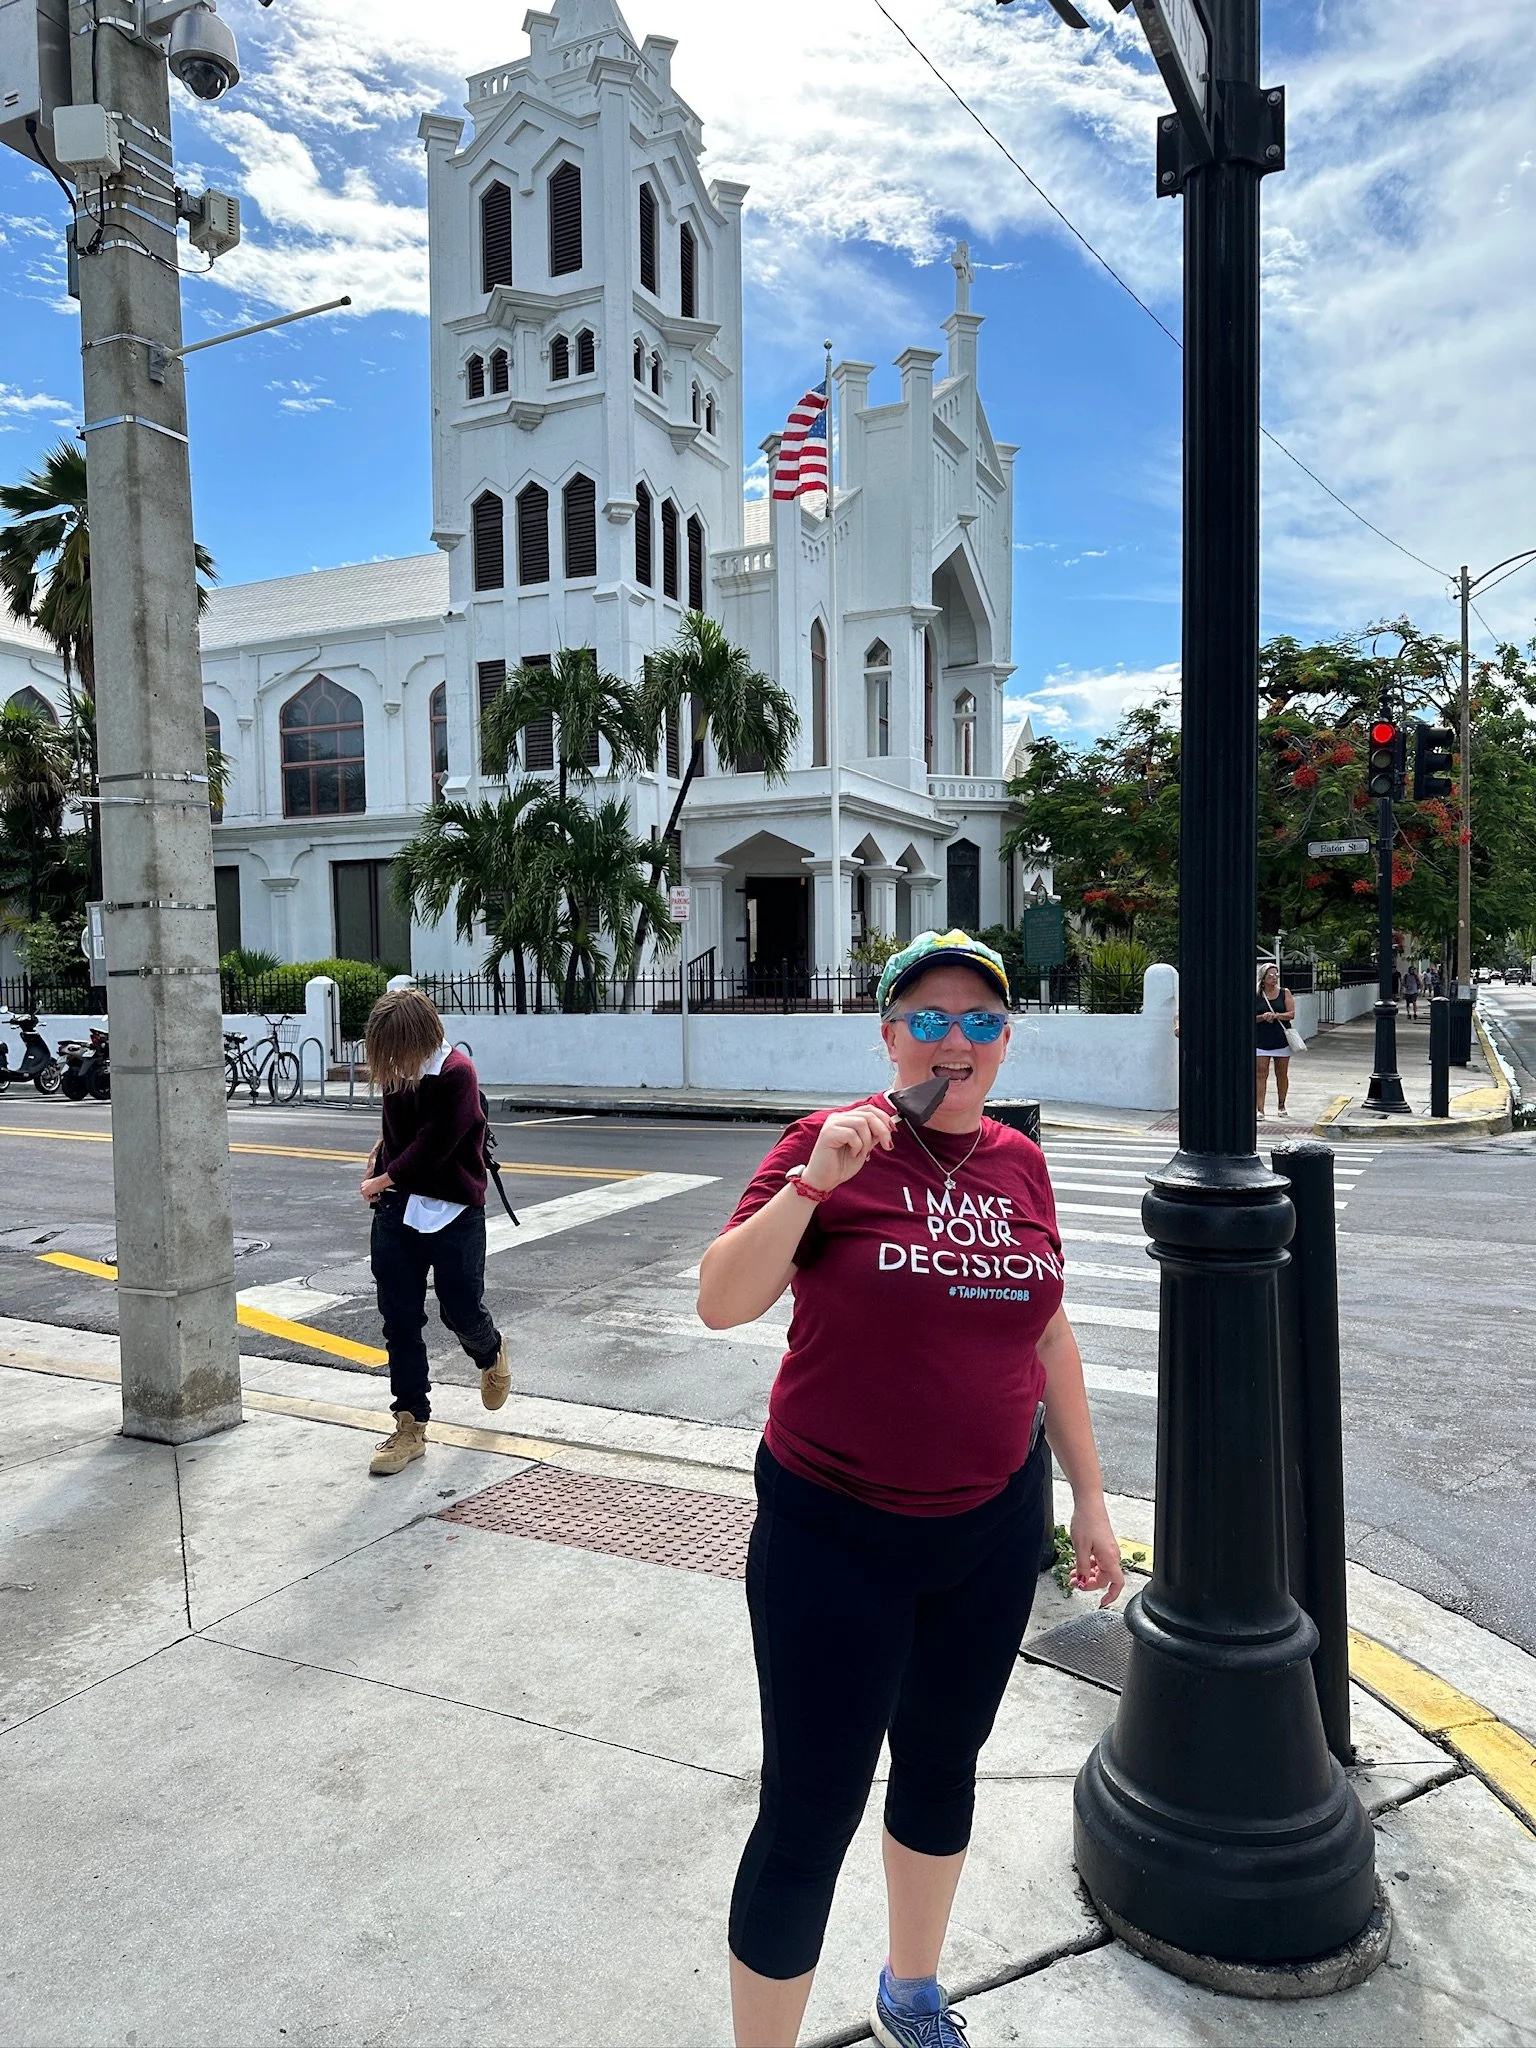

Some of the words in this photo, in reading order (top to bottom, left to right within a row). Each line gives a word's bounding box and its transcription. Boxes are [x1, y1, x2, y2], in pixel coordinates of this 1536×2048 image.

[1320, 844, 1345, 853] Eaton
[1348, 843, 1356, 851] St
[902, 1186, 914, 1213] I
[926, 1187, 1014, 1219] MAKE
[926, 1215, 1022, 1248] POUR
